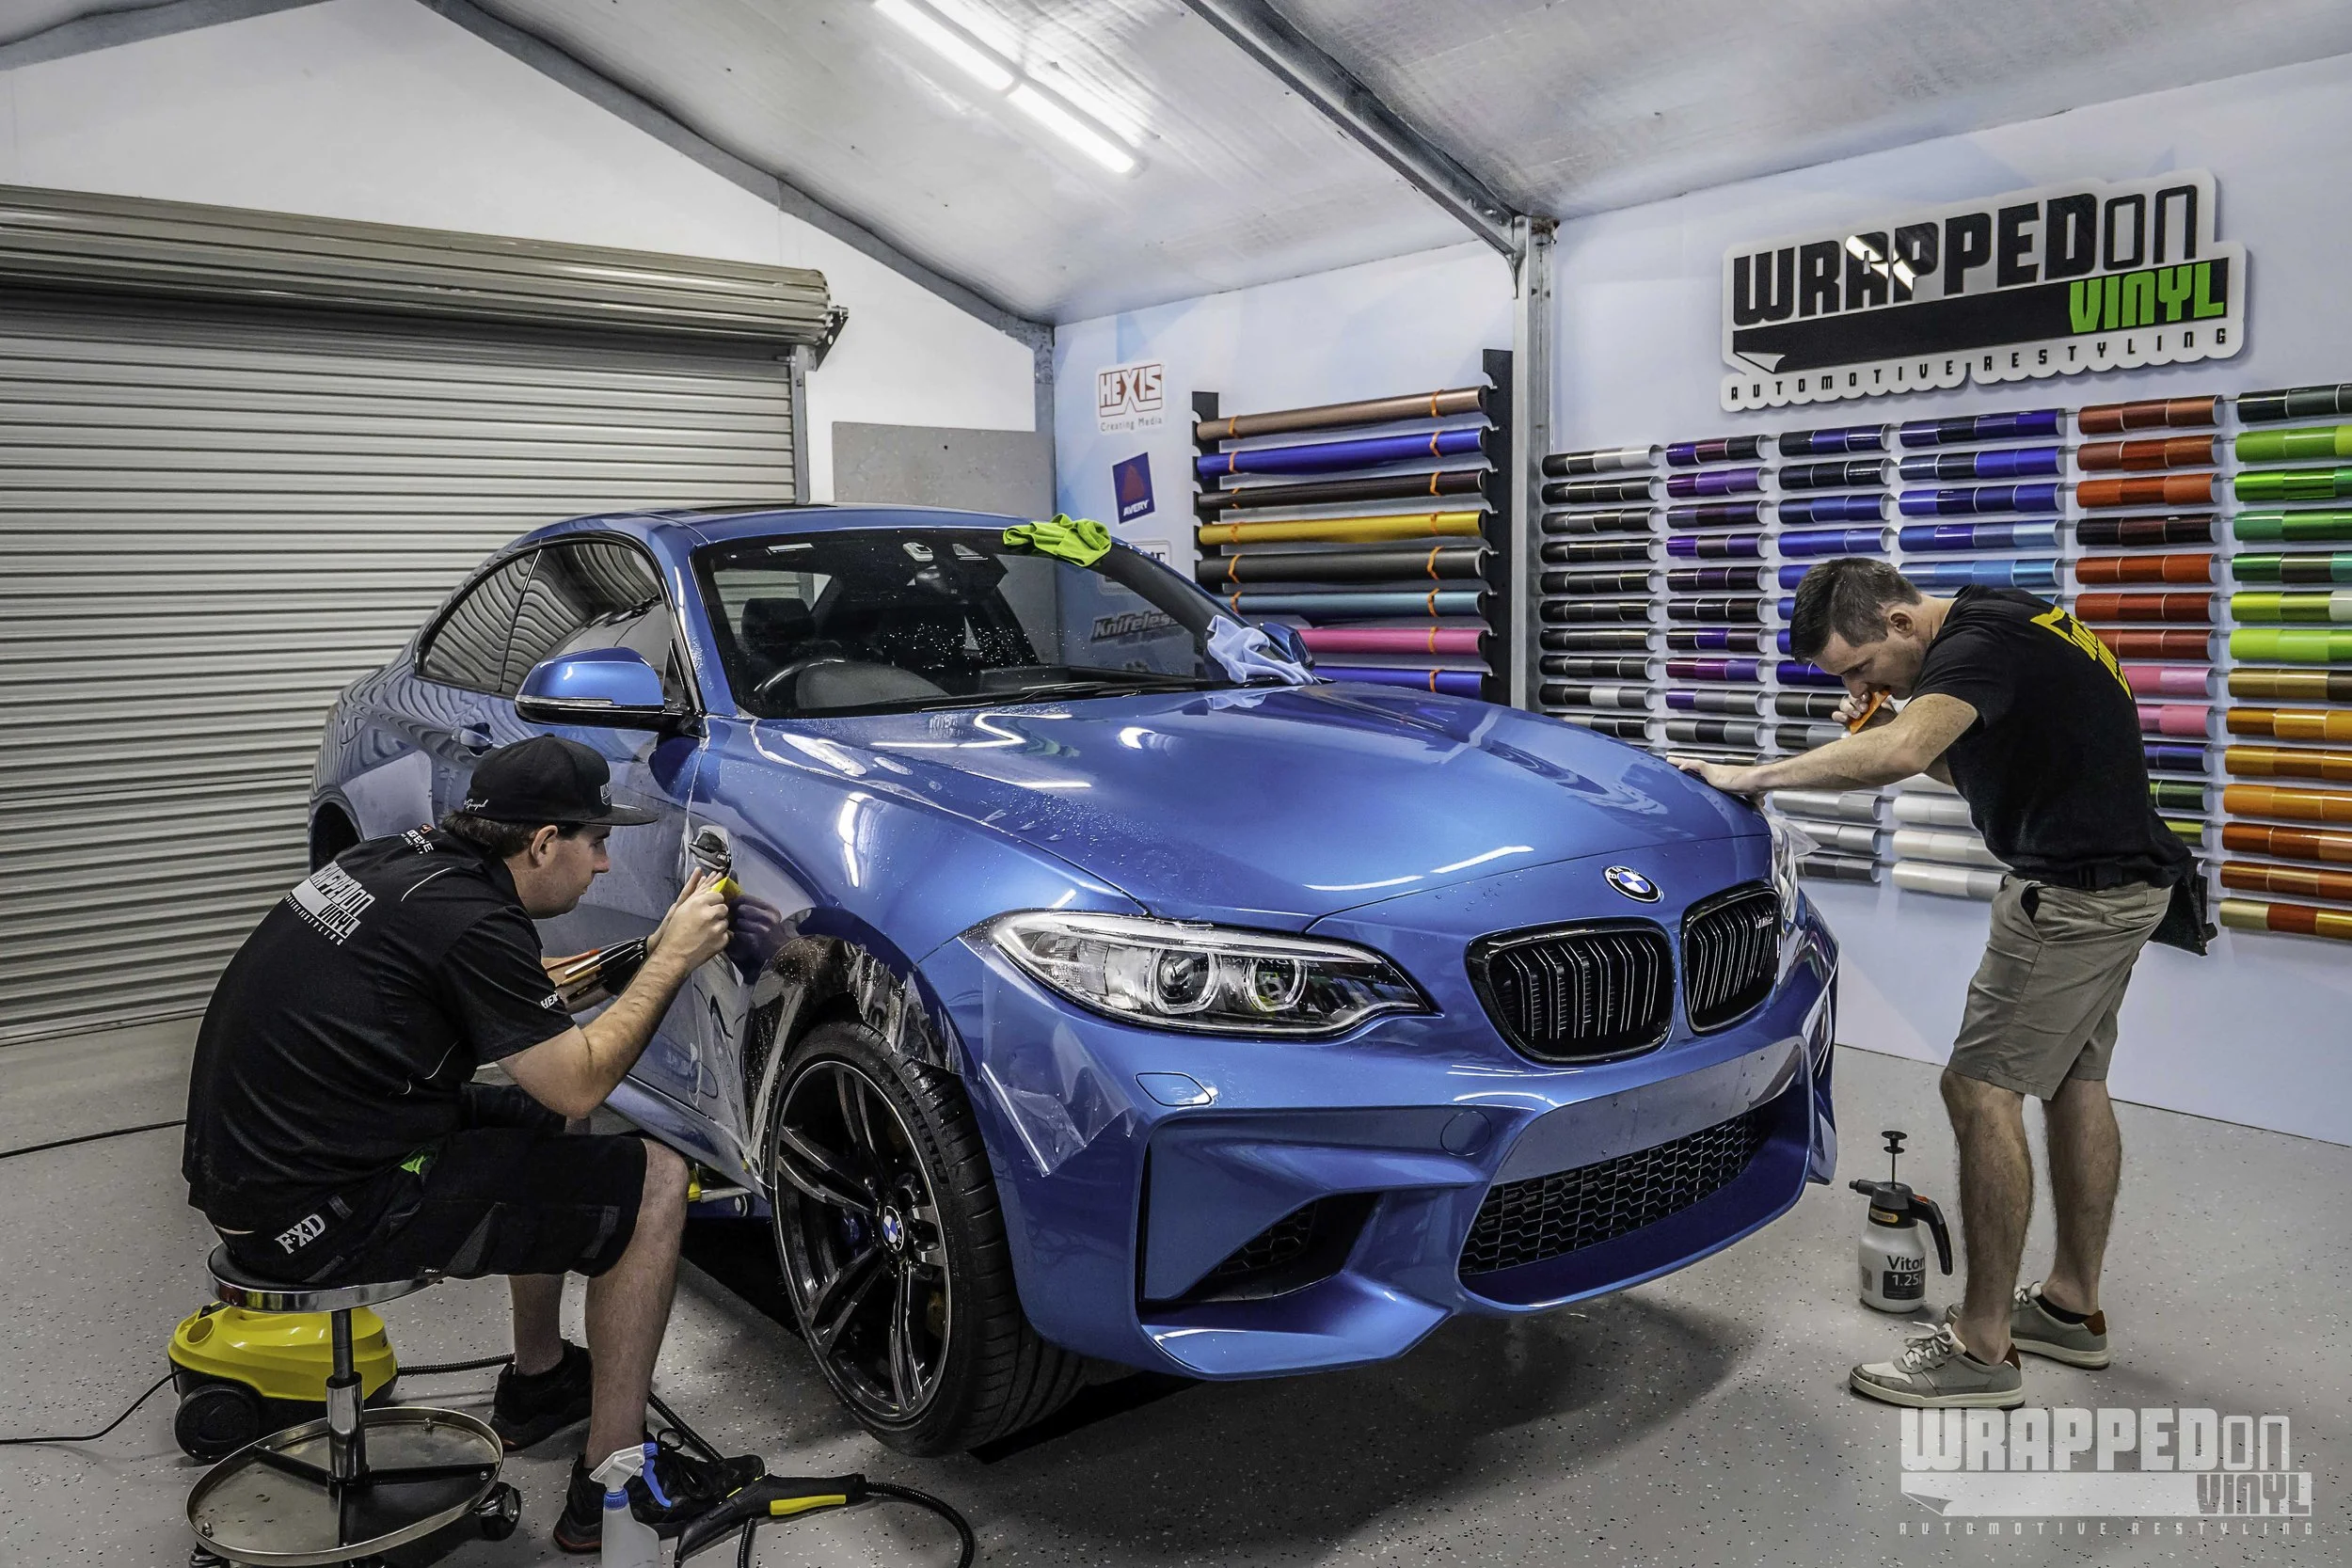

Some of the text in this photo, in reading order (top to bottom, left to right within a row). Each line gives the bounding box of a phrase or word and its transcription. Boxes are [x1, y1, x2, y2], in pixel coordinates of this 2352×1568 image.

[2070, 261, 2225, 334] VINYL
[1730, 327, 2227, 401] AUTOMOTIVE RESTYLING
[1099, 364, 1163, 418] HEXIS
[1101, 417, 1163, 432] Creating Media
[1123, 499, 1150, 516] AVERY
[317, 903, 357, 938] VINYL
